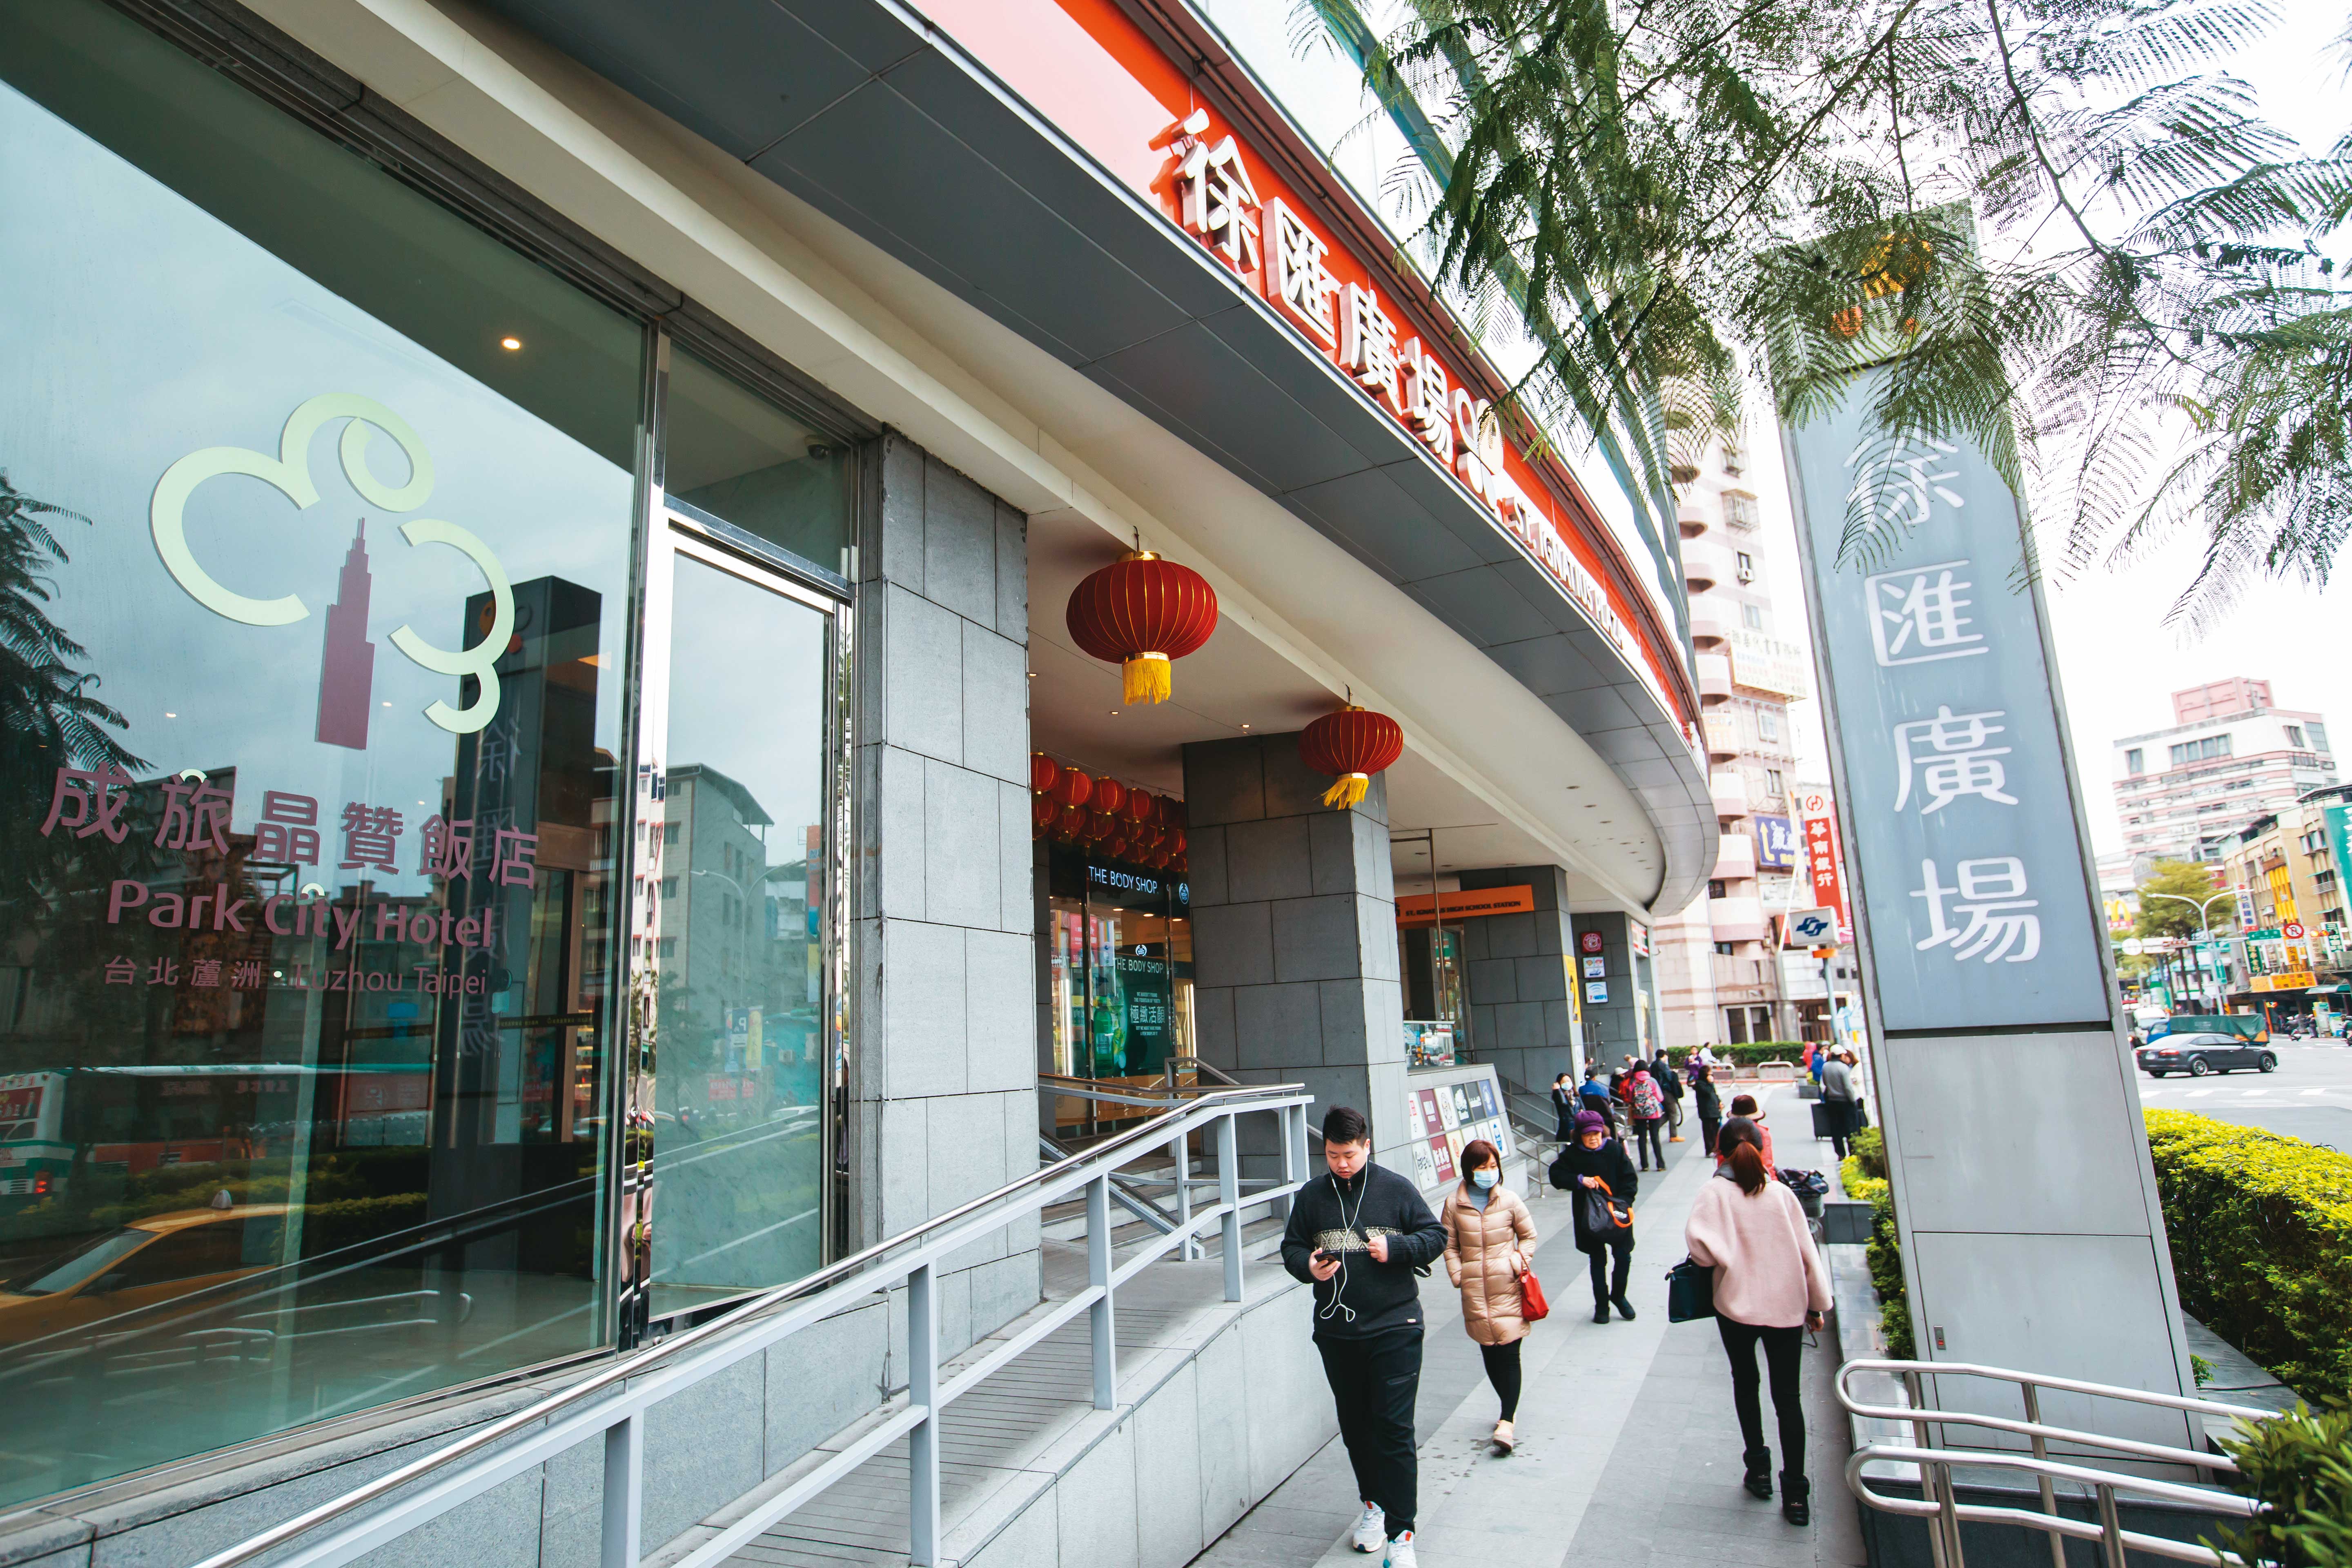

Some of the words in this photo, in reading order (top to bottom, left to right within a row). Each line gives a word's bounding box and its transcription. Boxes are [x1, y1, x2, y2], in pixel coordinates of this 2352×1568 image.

[1181, 107, 1454, 466] 徐匯廣場
[1512, 497, 1537, 549] ST.
[1541, 530, 1594, 612] IGNATIUS
[1595, 593, 1624, 650] PLAZA
[1843, 429, 2041, 964] 徐匯廣場
[1810, 821, 1833, 887] 華南銀行
[1088, 866, 1107, 884] THE
[1110, 871, 1134, 889] BODY
[1136, 877, 1158, 894] SHOP
[1493, 901, 1521, 909] STATION
[107, 879, 246, 932] Park
[265, 893, 362, 950] City
[376, 901, 492, 948] Hotel
[104, 954, 261, 989] 台北蘆洲
[294, 963, 403, 993] Luzhou
[413, 966, 486, 1000] Taipei
[1115, 957, 1126, 971] THE
[1128, 960, 1146, 972] BODY
[1147, 962, 1163, 973] SHOP
